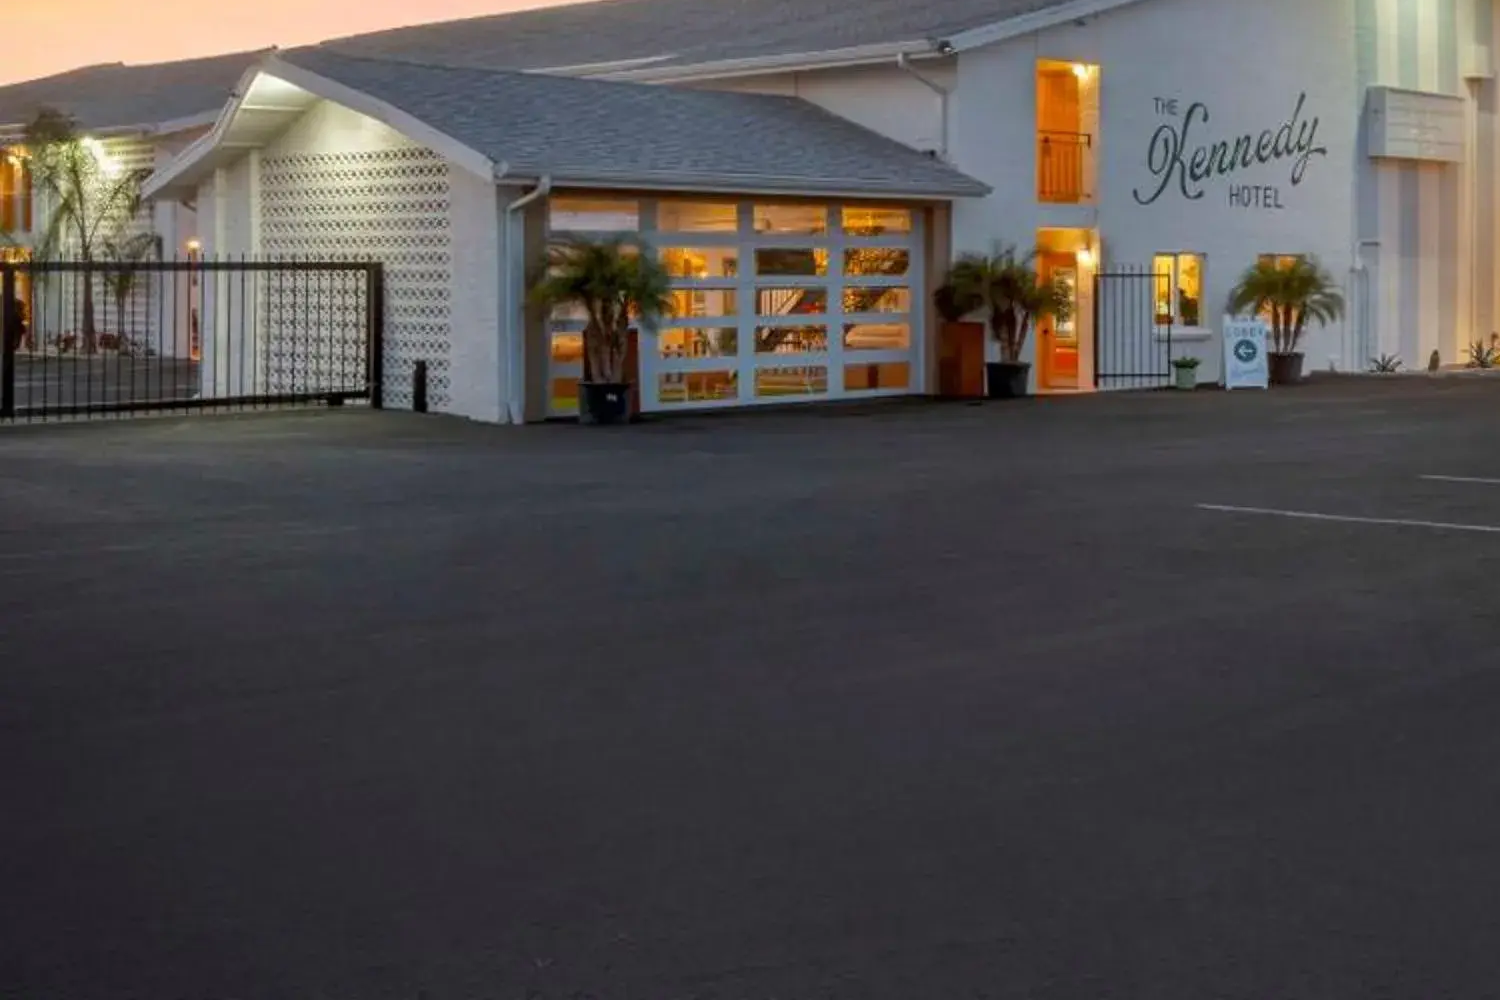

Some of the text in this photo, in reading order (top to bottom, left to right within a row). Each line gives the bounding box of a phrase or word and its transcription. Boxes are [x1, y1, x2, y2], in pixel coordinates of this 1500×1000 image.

[1152, 97, 1179, 116] THE
[1132, 90, 1328, 206] Kennedy
[1229, 184, 1285, 209] HOTEL
